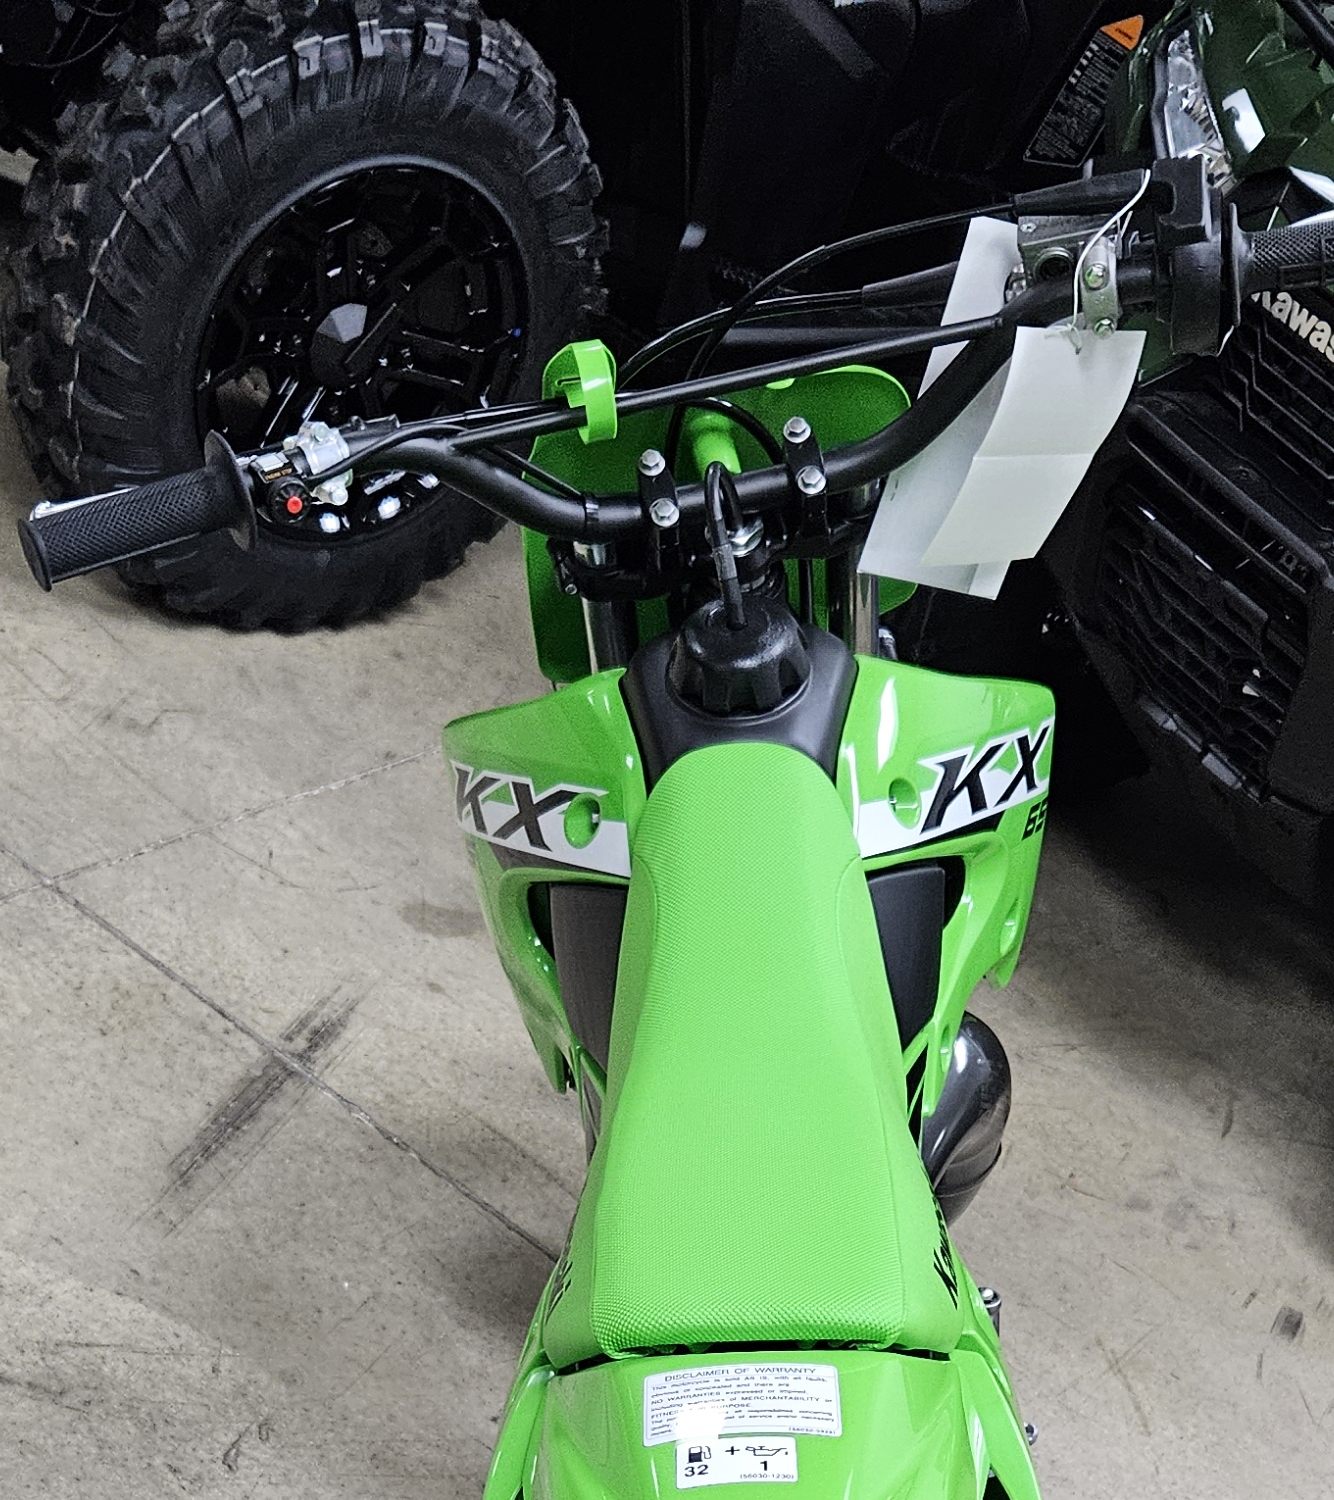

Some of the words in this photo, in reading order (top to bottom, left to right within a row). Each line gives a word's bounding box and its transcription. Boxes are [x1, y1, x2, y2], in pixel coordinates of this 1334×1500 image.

[919, 725, 1051, 835] KX
[454, 765, 582, 852] KX
[665, 1369, 729, 1382] DISCLAIMER
[684, 1464, 709, 1477] 32
[760, 1460, 768, 1471] 1
